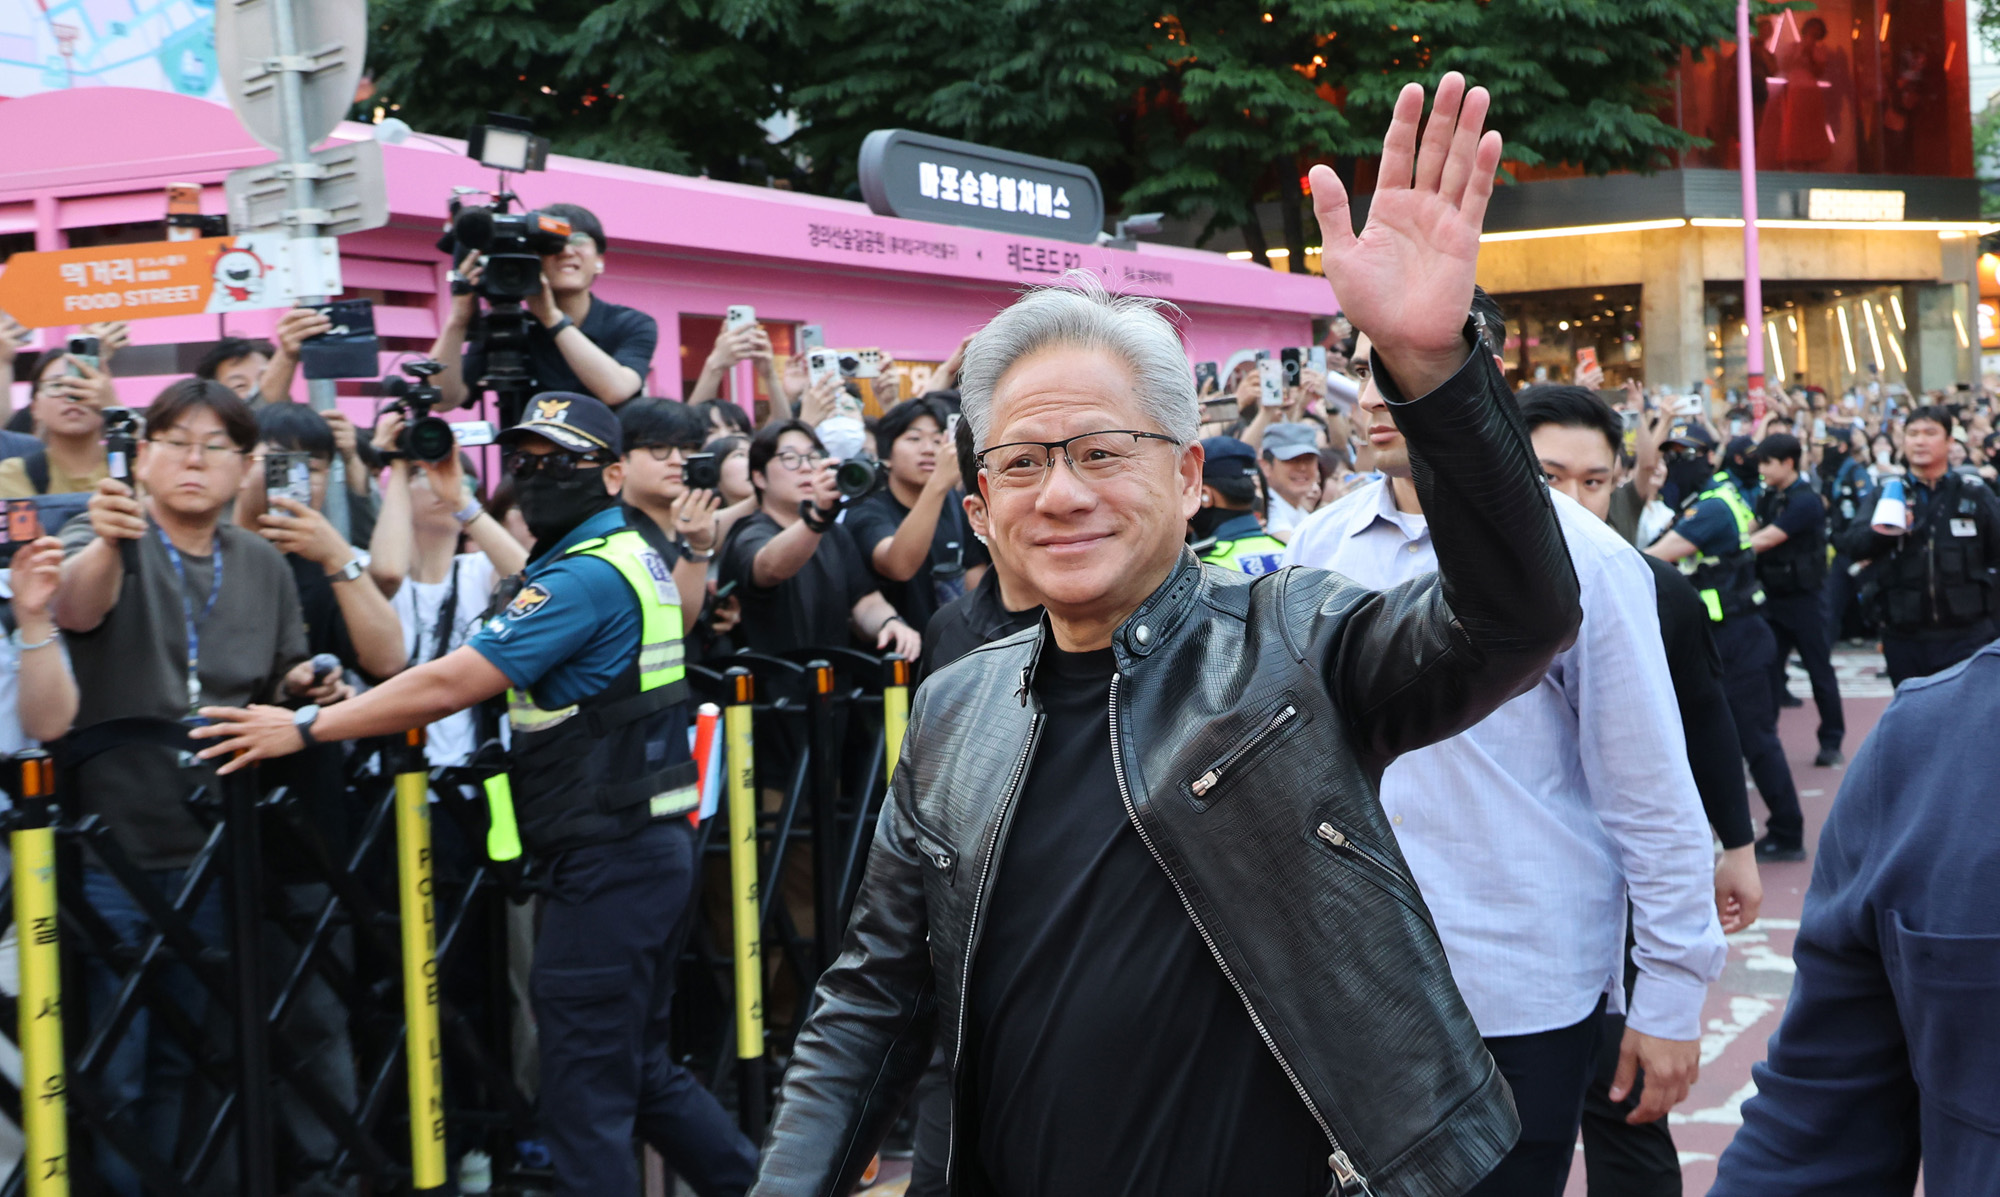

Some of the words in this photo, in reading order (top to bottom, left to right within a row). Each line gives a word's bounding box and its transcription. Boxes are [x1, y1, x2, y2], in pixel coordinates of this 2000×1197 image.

[59, 258, 136, 288] 먹거리
[1007, 244, 1060, 274] 레드로드
[64, 292, 122, 312] FOOD
[124, 285, 200, 307] STREET
